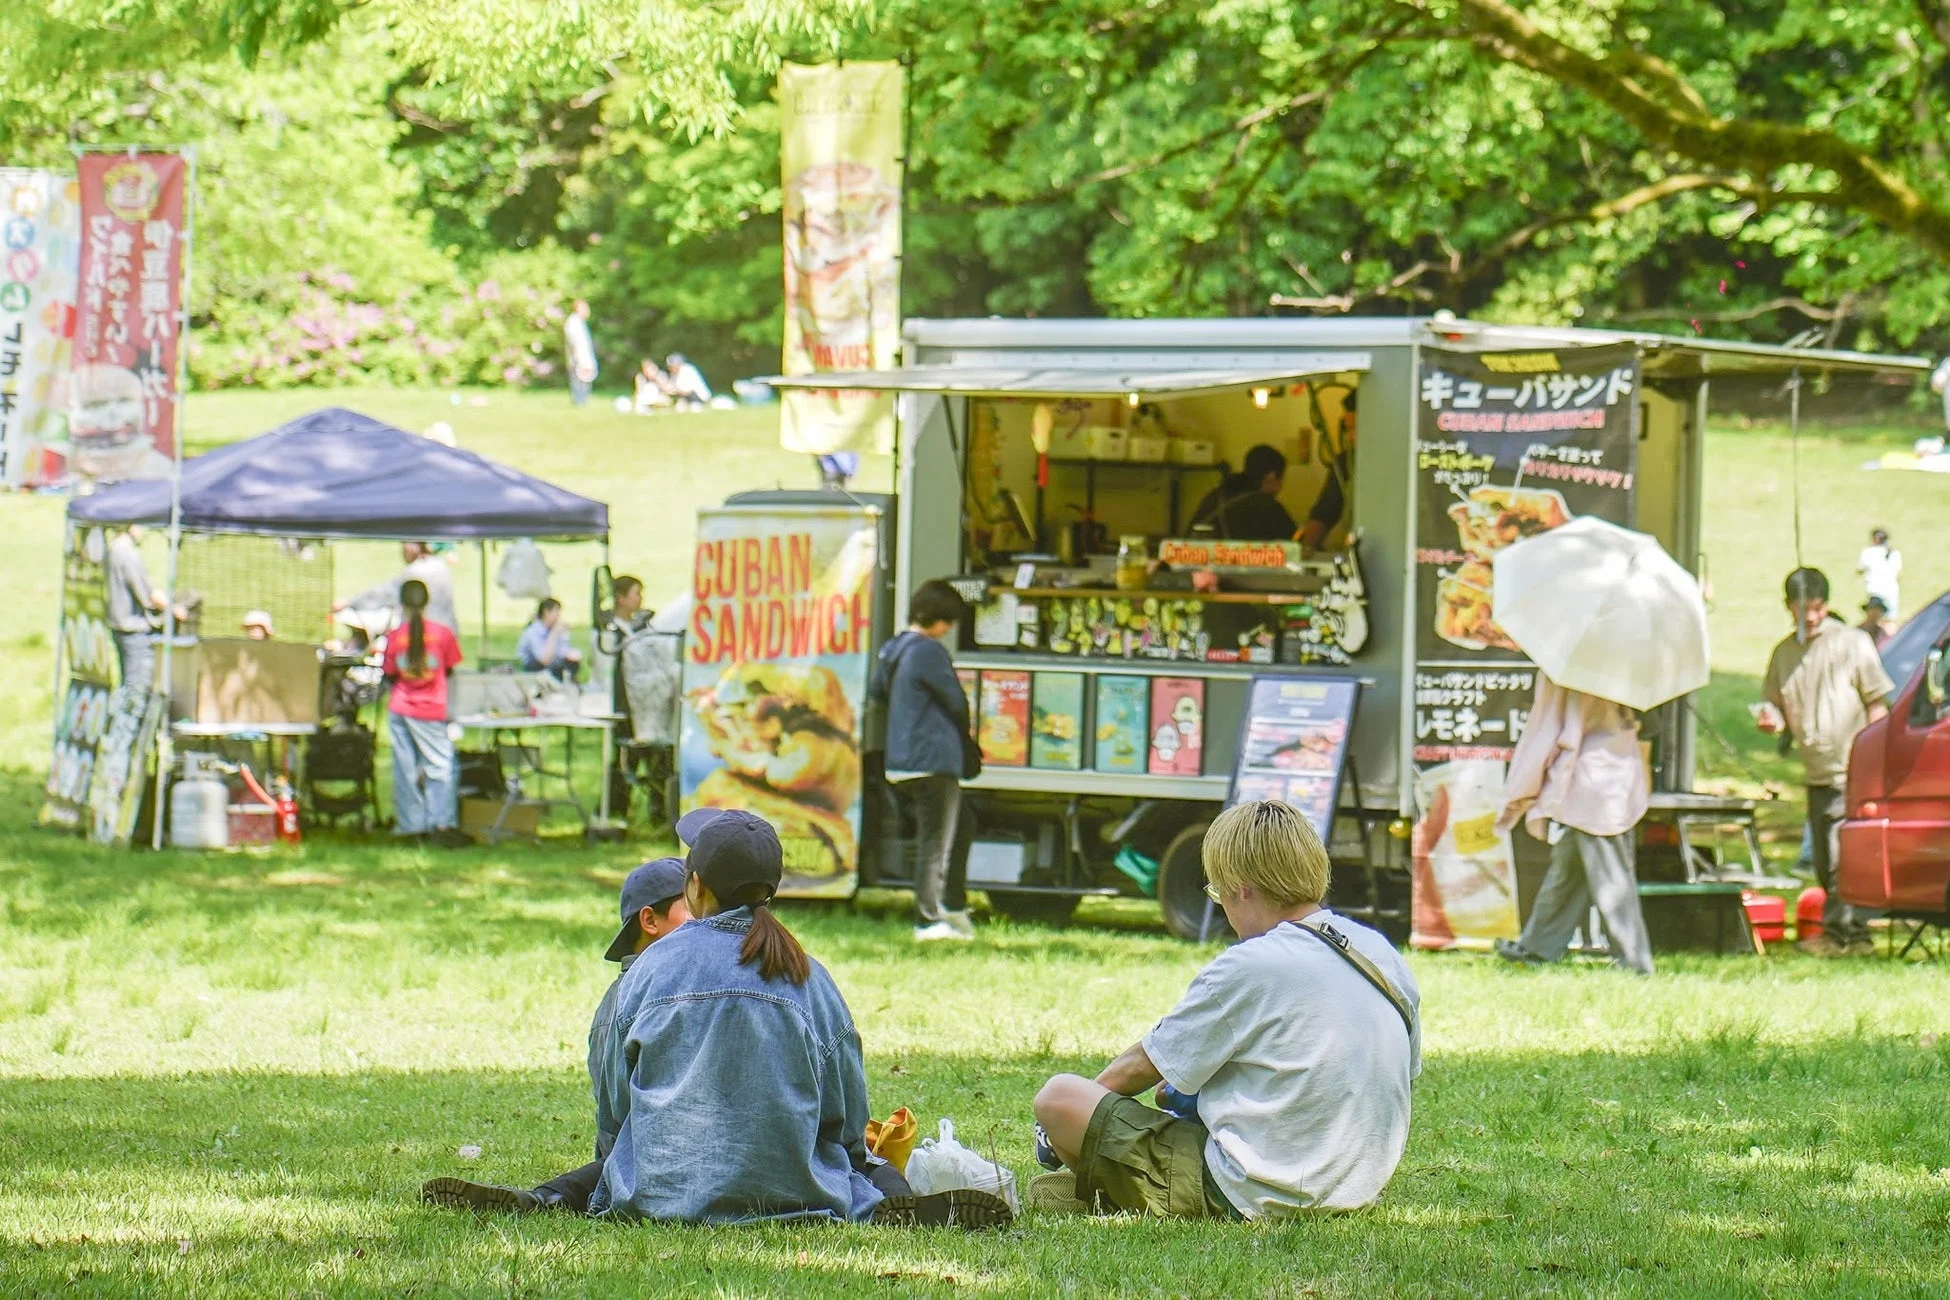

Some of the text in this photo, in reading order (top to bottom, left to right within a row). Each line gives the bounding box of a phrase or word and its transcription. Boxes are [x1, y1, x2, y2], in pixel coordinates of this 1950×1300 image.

[1421, 367, 1634, 410] キューバサンド
[694, 533, 813, 602] CUBAN
